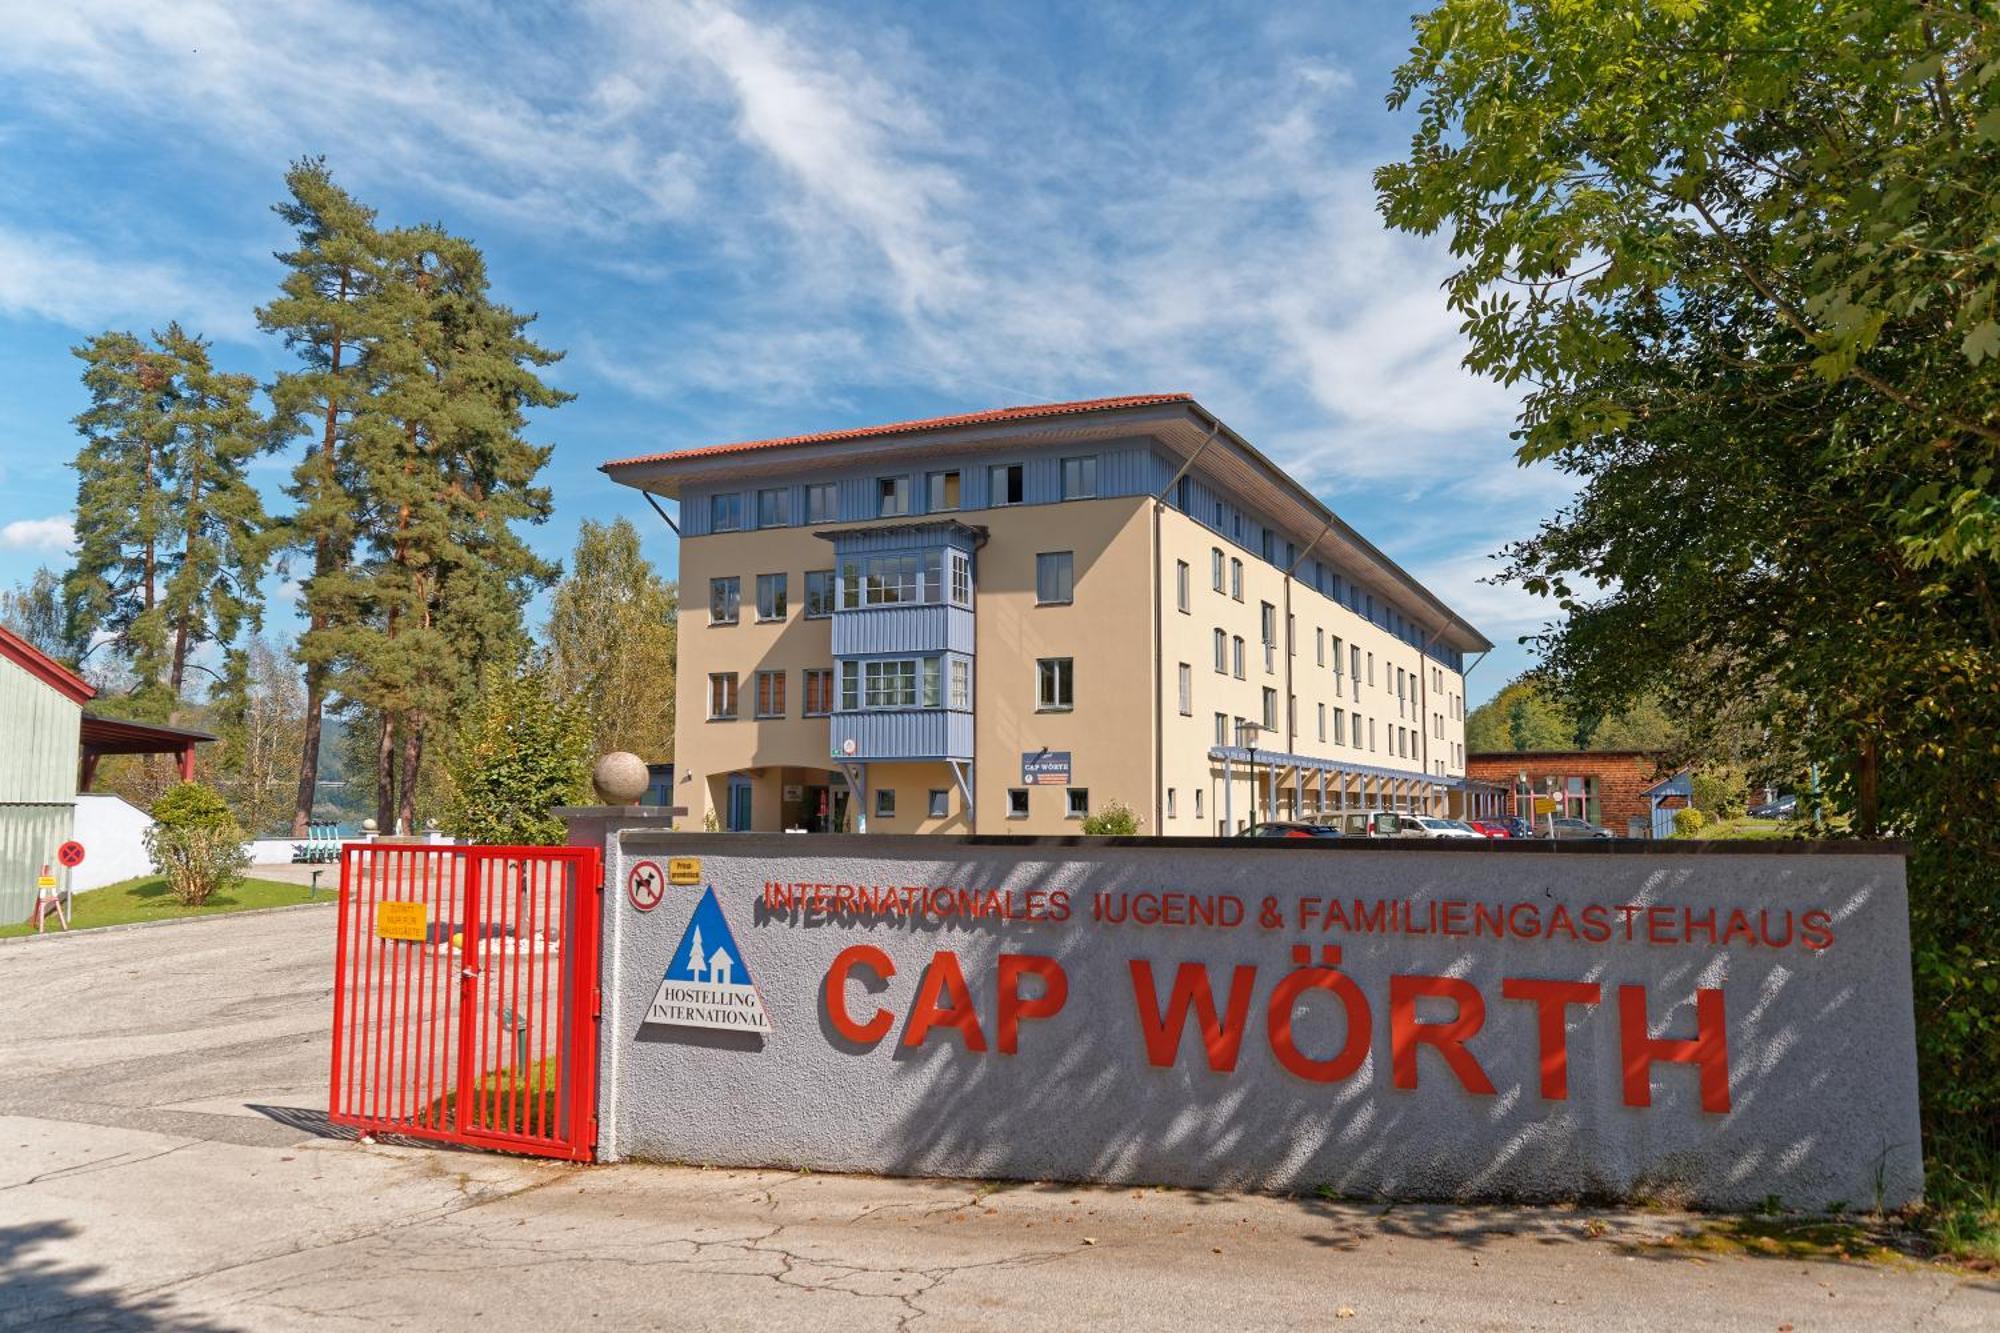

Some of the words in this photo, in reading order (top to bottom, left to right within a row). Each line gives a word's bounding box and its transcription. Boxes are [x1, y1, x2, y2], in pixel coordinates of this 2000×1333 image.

[762, 881, 1071, 921] INTERNATIONALES
[1259, 896, 1283, 929] &
[1300, 898, 1834, 950] FAMILIENGASTEHAUS
[653, 1003, 767, 1027] INTERNATIONAL
[664, 987, 755, 1008] HOSTELLING
[826, 945, 1067, 1056] CAP
[1130, 945, 1732, 1114] WÖRTH
